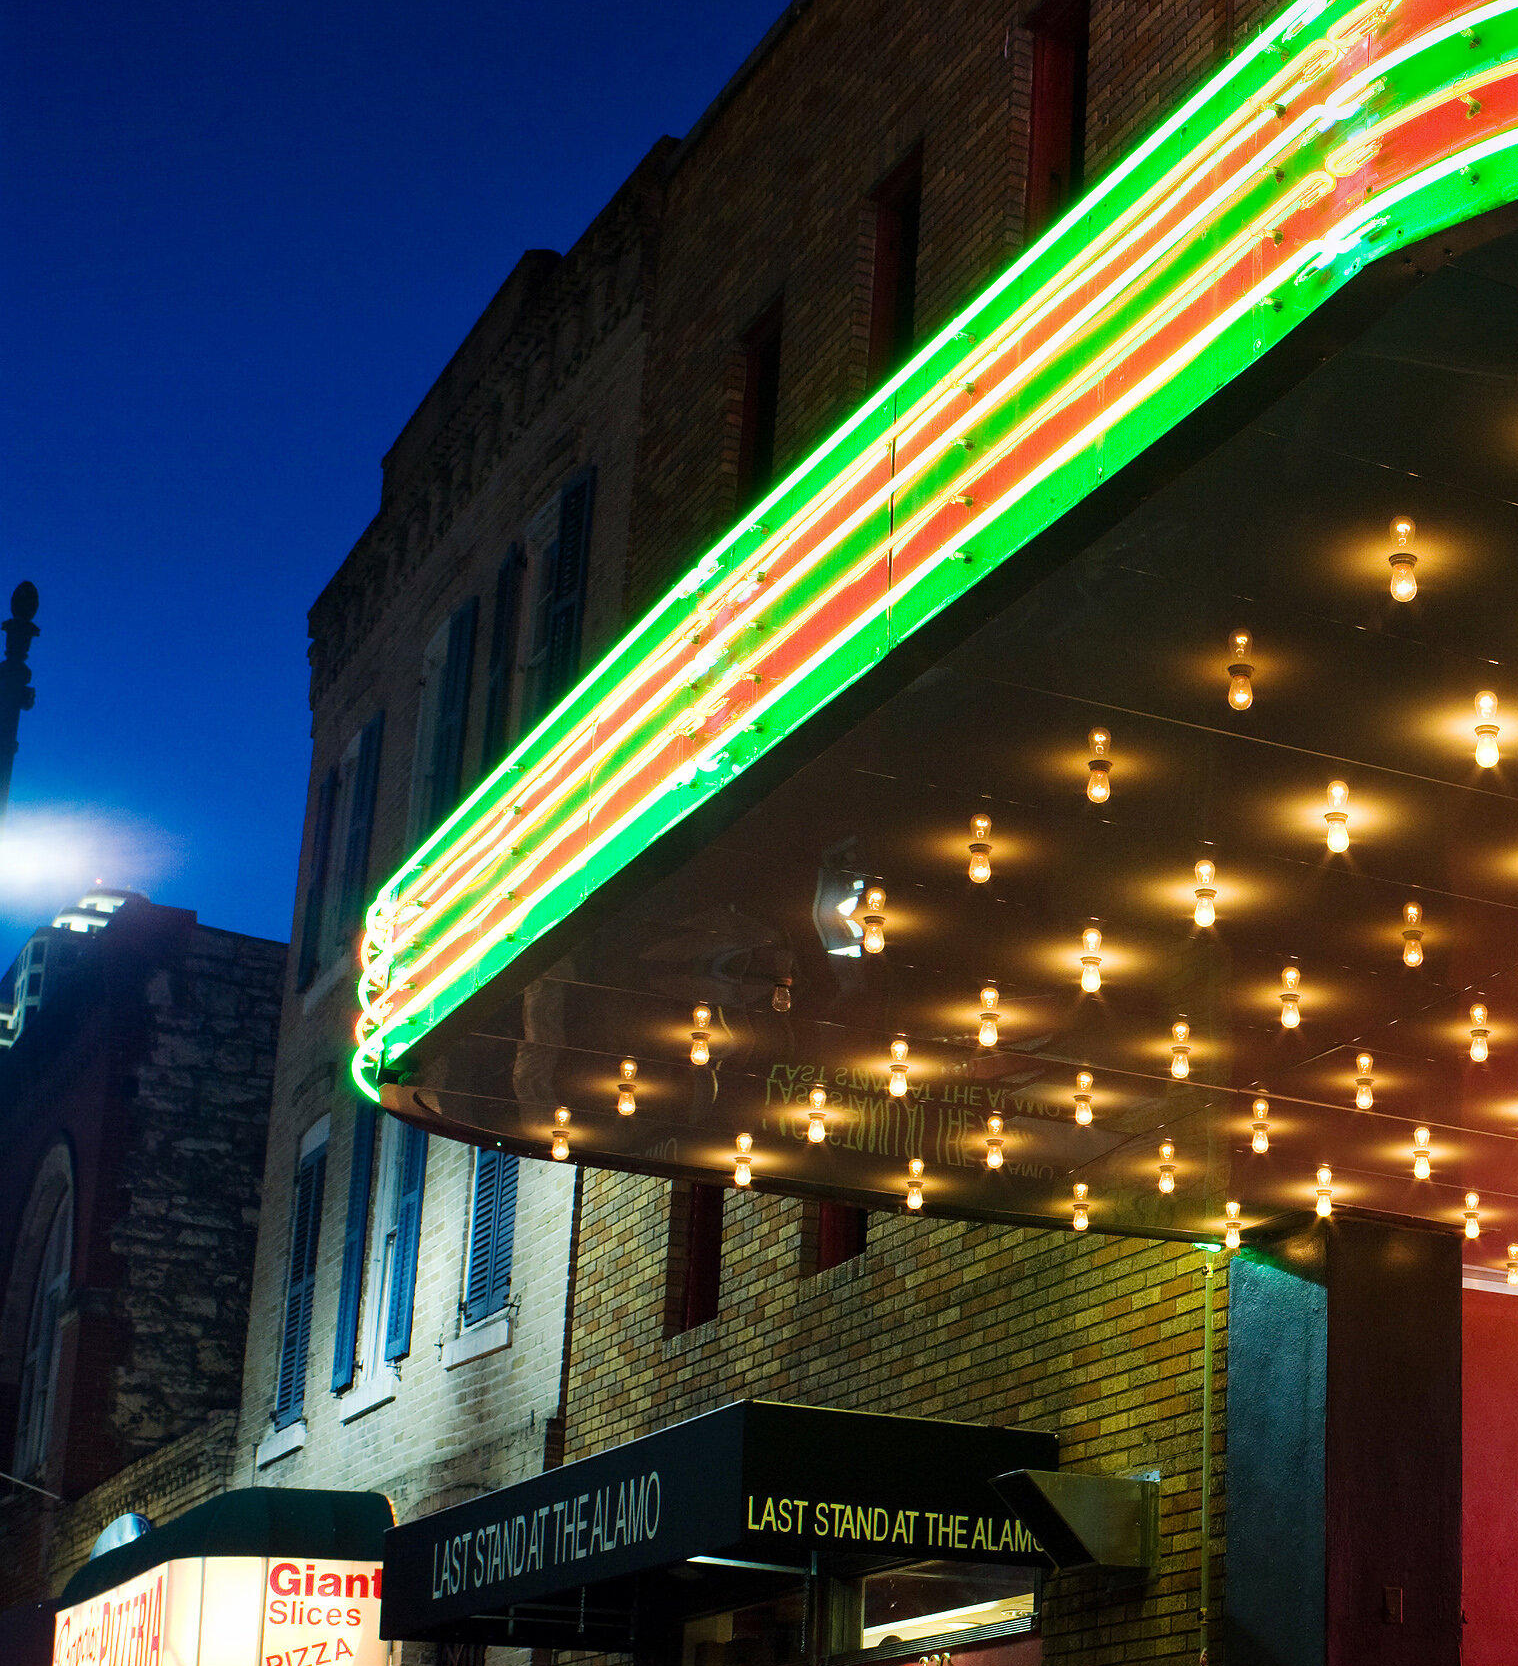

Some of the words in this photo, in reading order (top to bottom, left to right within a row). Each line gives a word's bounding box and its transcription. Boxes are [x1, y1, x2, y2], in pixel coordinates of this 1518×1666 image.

[432, 1532, 472, 1600] LAST
[474, 1515, 526, 1588] STAND
[527, 1506, 549, 1573] AT
[553, 1493, 589, 1565] THE
[590, 1471, 660, 1557] ALAMO
[748, 1495, 808, 1534] LAST
[814, 1502, 889, 1541] STAND
[892, 1509, 919, 1544] AT
[925, 1512, 969, 1549] THE
[269, 1563, 382, 1600] Giant
[269, 1600, 360, 1626] Slices
